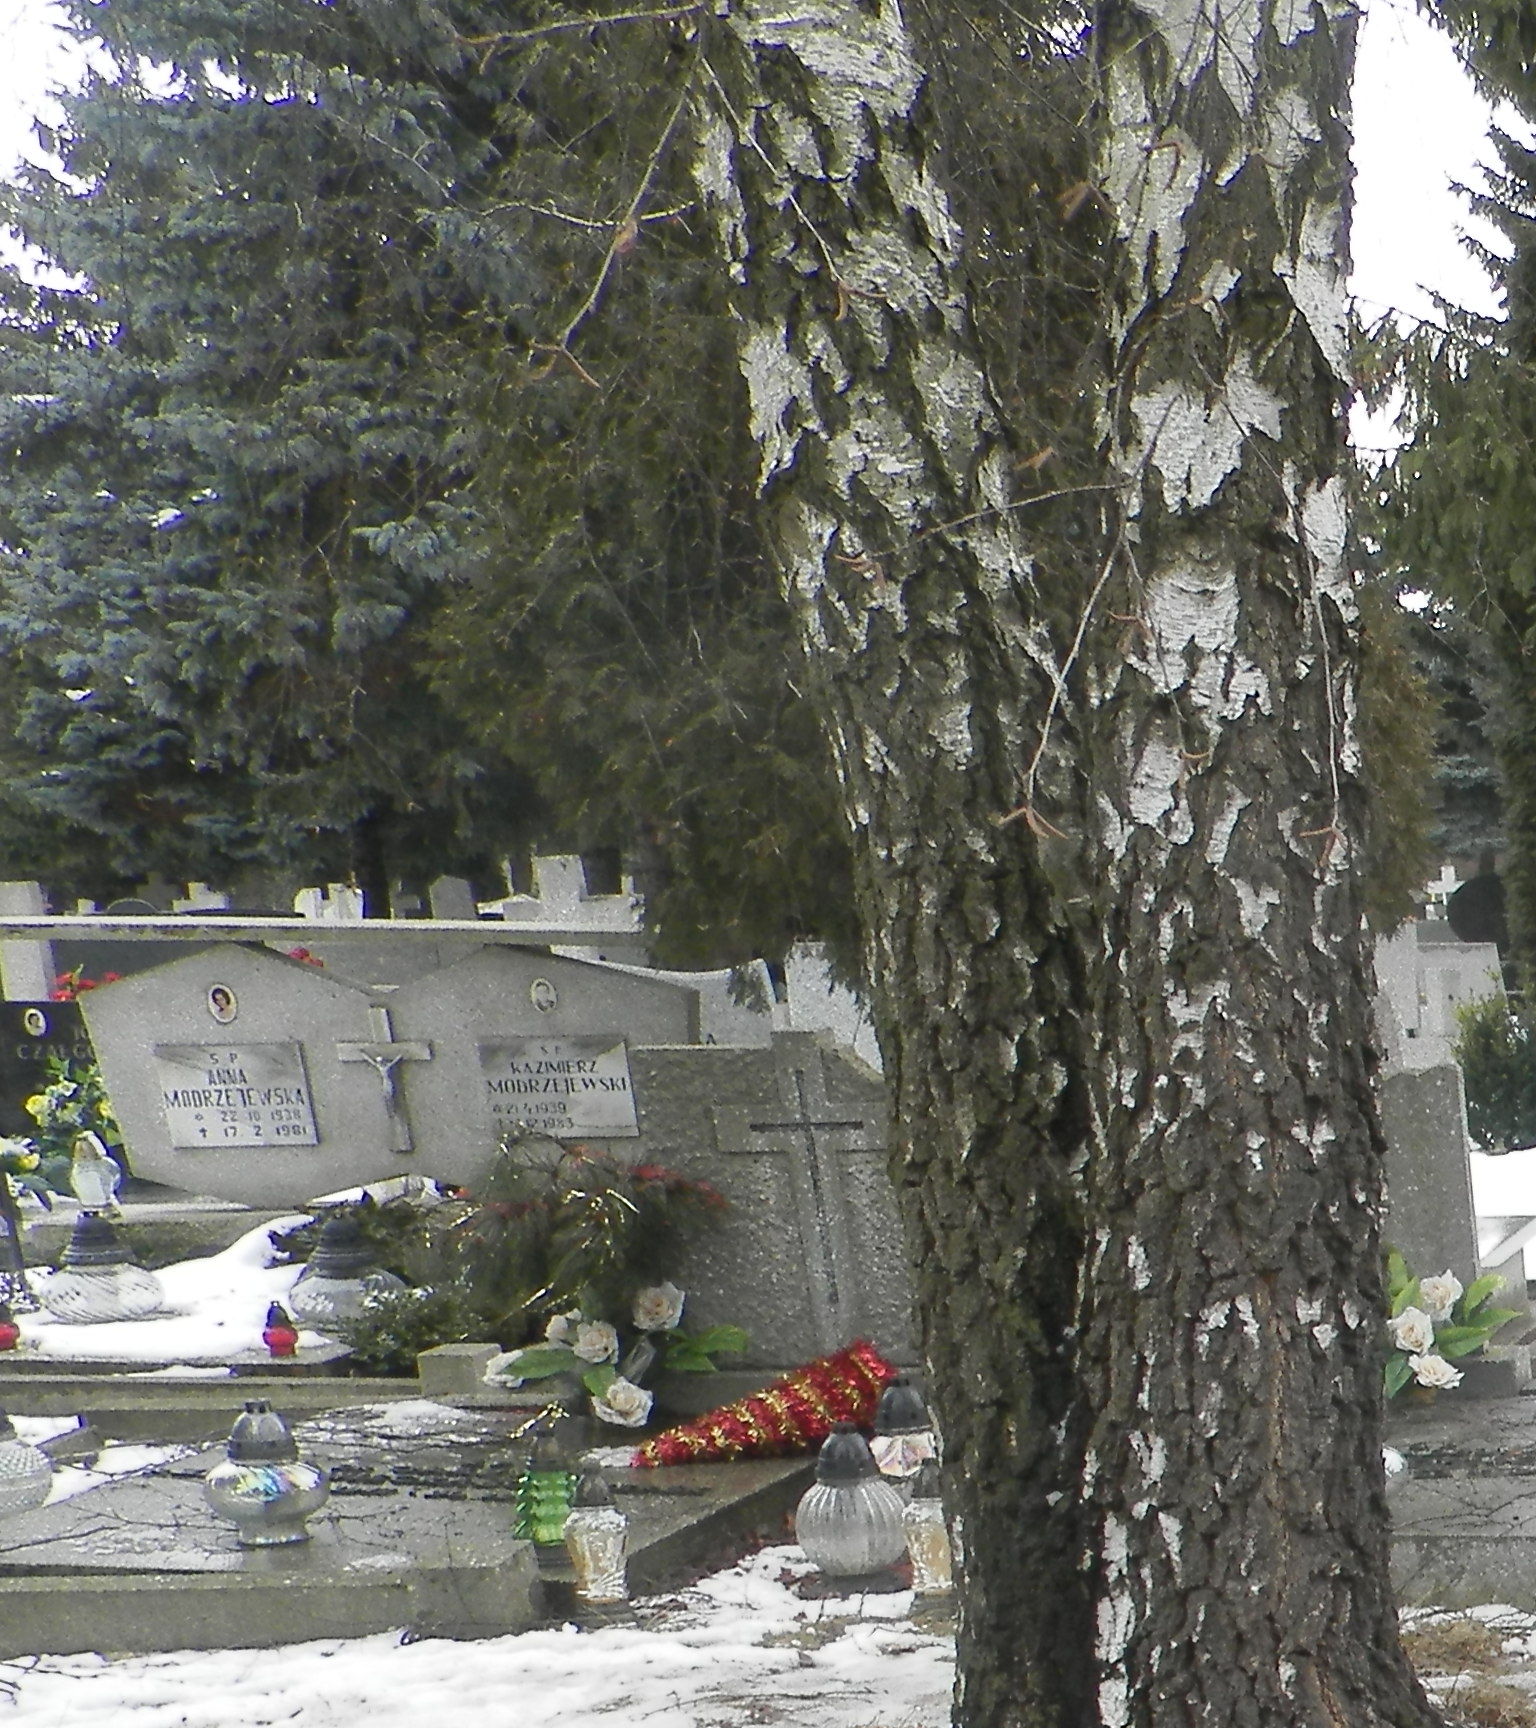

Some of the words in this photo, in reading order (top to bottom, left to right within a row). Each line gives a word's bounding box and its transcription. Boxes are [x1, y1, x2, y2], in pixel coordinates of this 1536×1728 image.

[510, 1059, 600, 1076] KAZIMIERZ
[207, 1068, 249, 1087] ANNA
[486, 1076, 628, 1096] MODRZEJEWSKI
